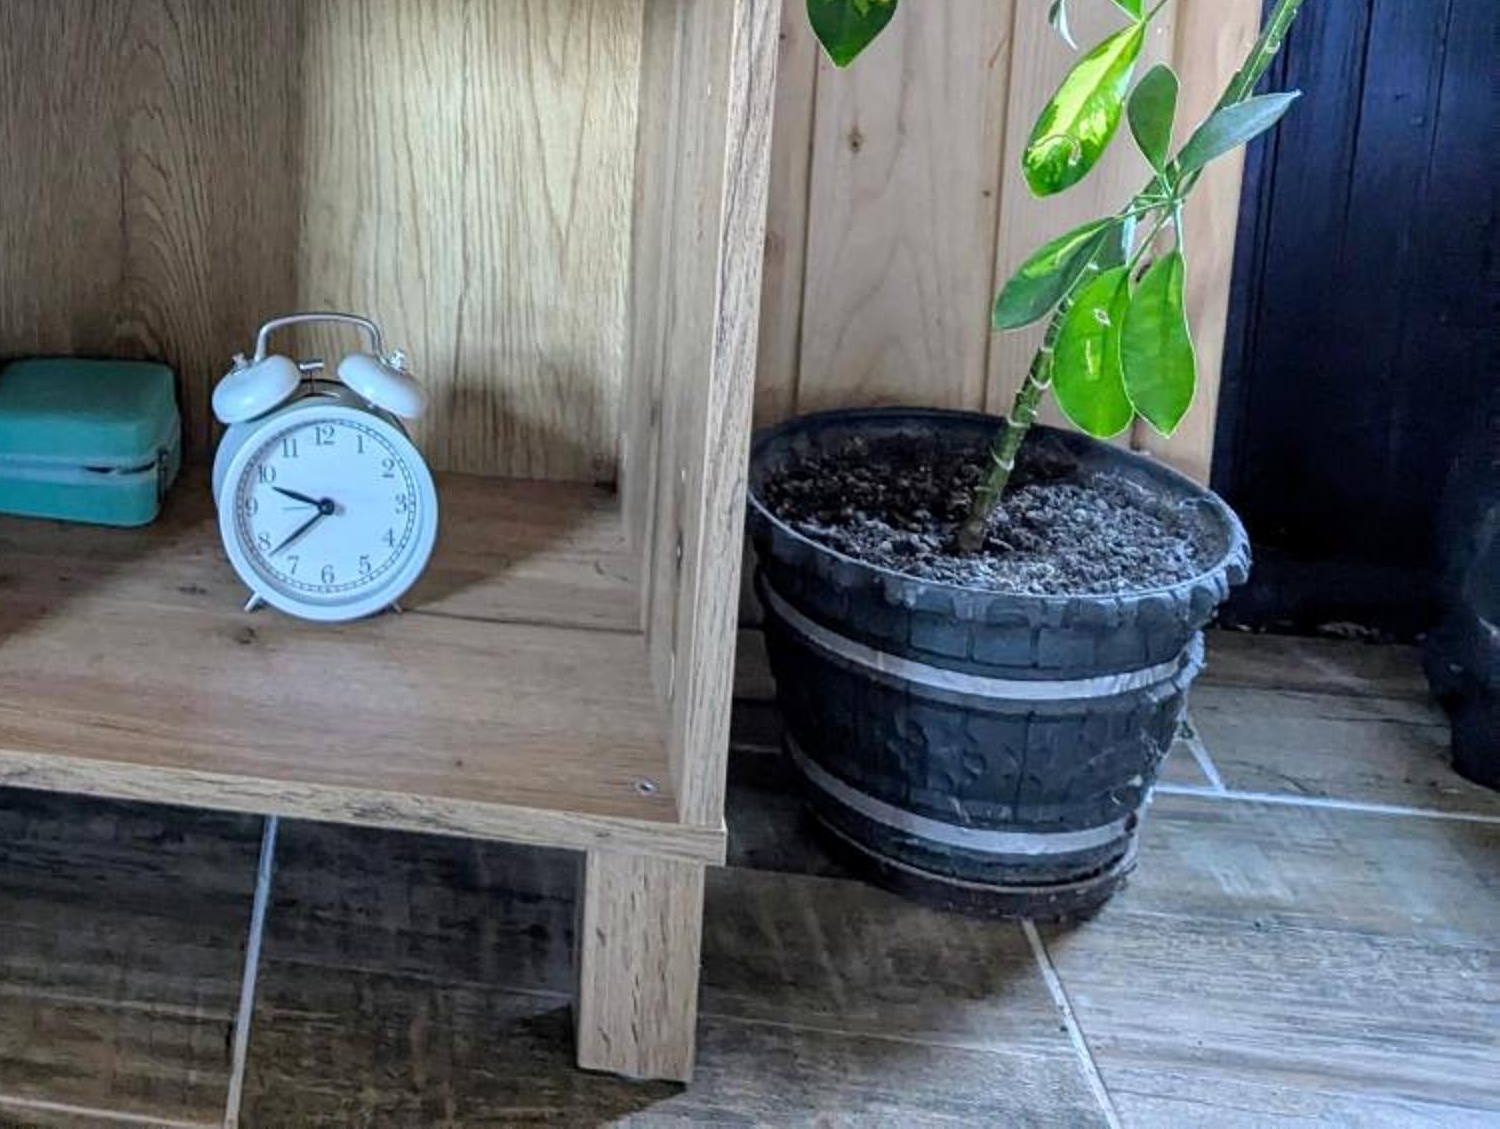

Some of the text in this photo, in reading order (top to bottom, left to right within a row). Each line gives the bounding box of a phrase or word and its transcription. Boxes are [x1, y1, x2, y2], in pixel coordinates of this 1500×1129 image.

[315, 425, 335, 446] 12
[356, 434, 365, 454] 1
[283, 438, 300, 458] 11
[258, 465, 276, 483] 10
[381, 458, 395, 478] 2
[245, 498, 259, 515] 9
[395, 494, 409, 514] 3
[258, 533, 273, 551] 8
[382, 527, 395, 548] 4
[287, 555, 300, 575] 7
[321, 566, 335, 584] 6
[358, 556, 372, 575] 5
